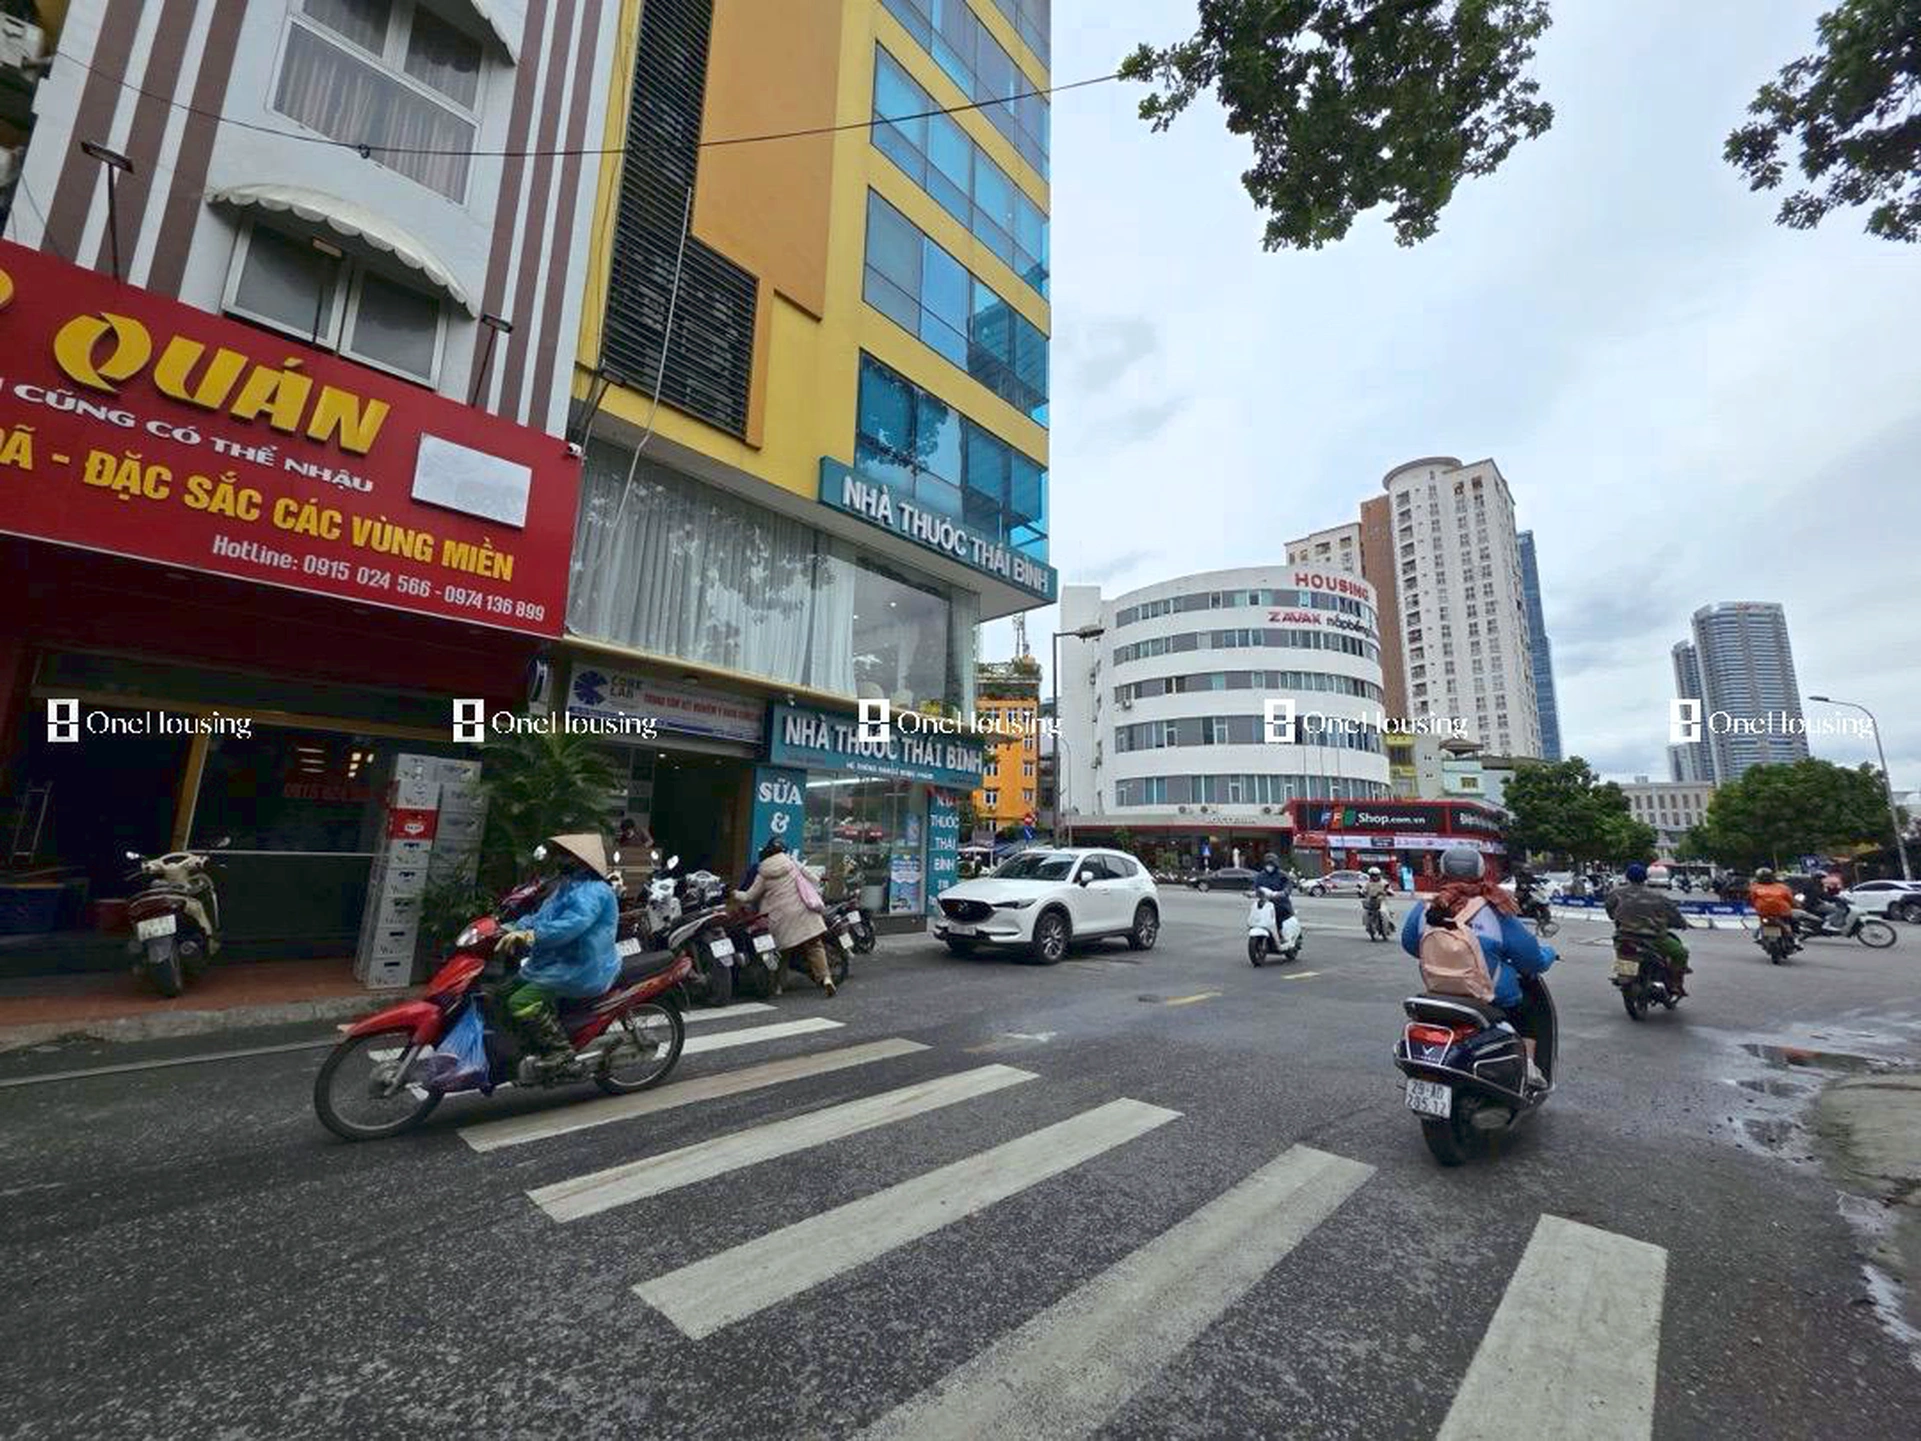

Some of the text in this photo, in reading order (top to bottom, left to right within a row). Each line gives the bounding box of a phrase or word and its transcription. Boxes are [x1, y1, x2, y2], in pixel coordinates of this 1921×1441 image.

[53, 311, 391, 455] QUÁN
[13, 384, 136, 428] CŨNG
[146, 420, 201, 446] CÓ
[284, 458, 373, 492] NHẬU
[84, 449, 172, 500] ĐẶC
[184, 471, 262, 521] SẮC
[273, 497, 342, 540] CÁC
[352, 515, 435, 562] VÙNG
[442, 536, 514, 581] MIỀN
[842, 476, 1049, 593] NHÀ THUỐC THÁI BÌNH
[303, 554, 350, 581] 0915
[356, 566, 390, 590] 024
[397, 575, 431, 598] 566
[444, 585, 482, 609] 0974
[486, 595, 513, 615] 136
[516, 599, 545, 622] 899
[1268, 611, 1321, 625] ZAVAK
[785, 714, 829, 750] NHÀ
[902, 736, 943, 768] THÁI
[946, 742, 983, 774] BÌNH
